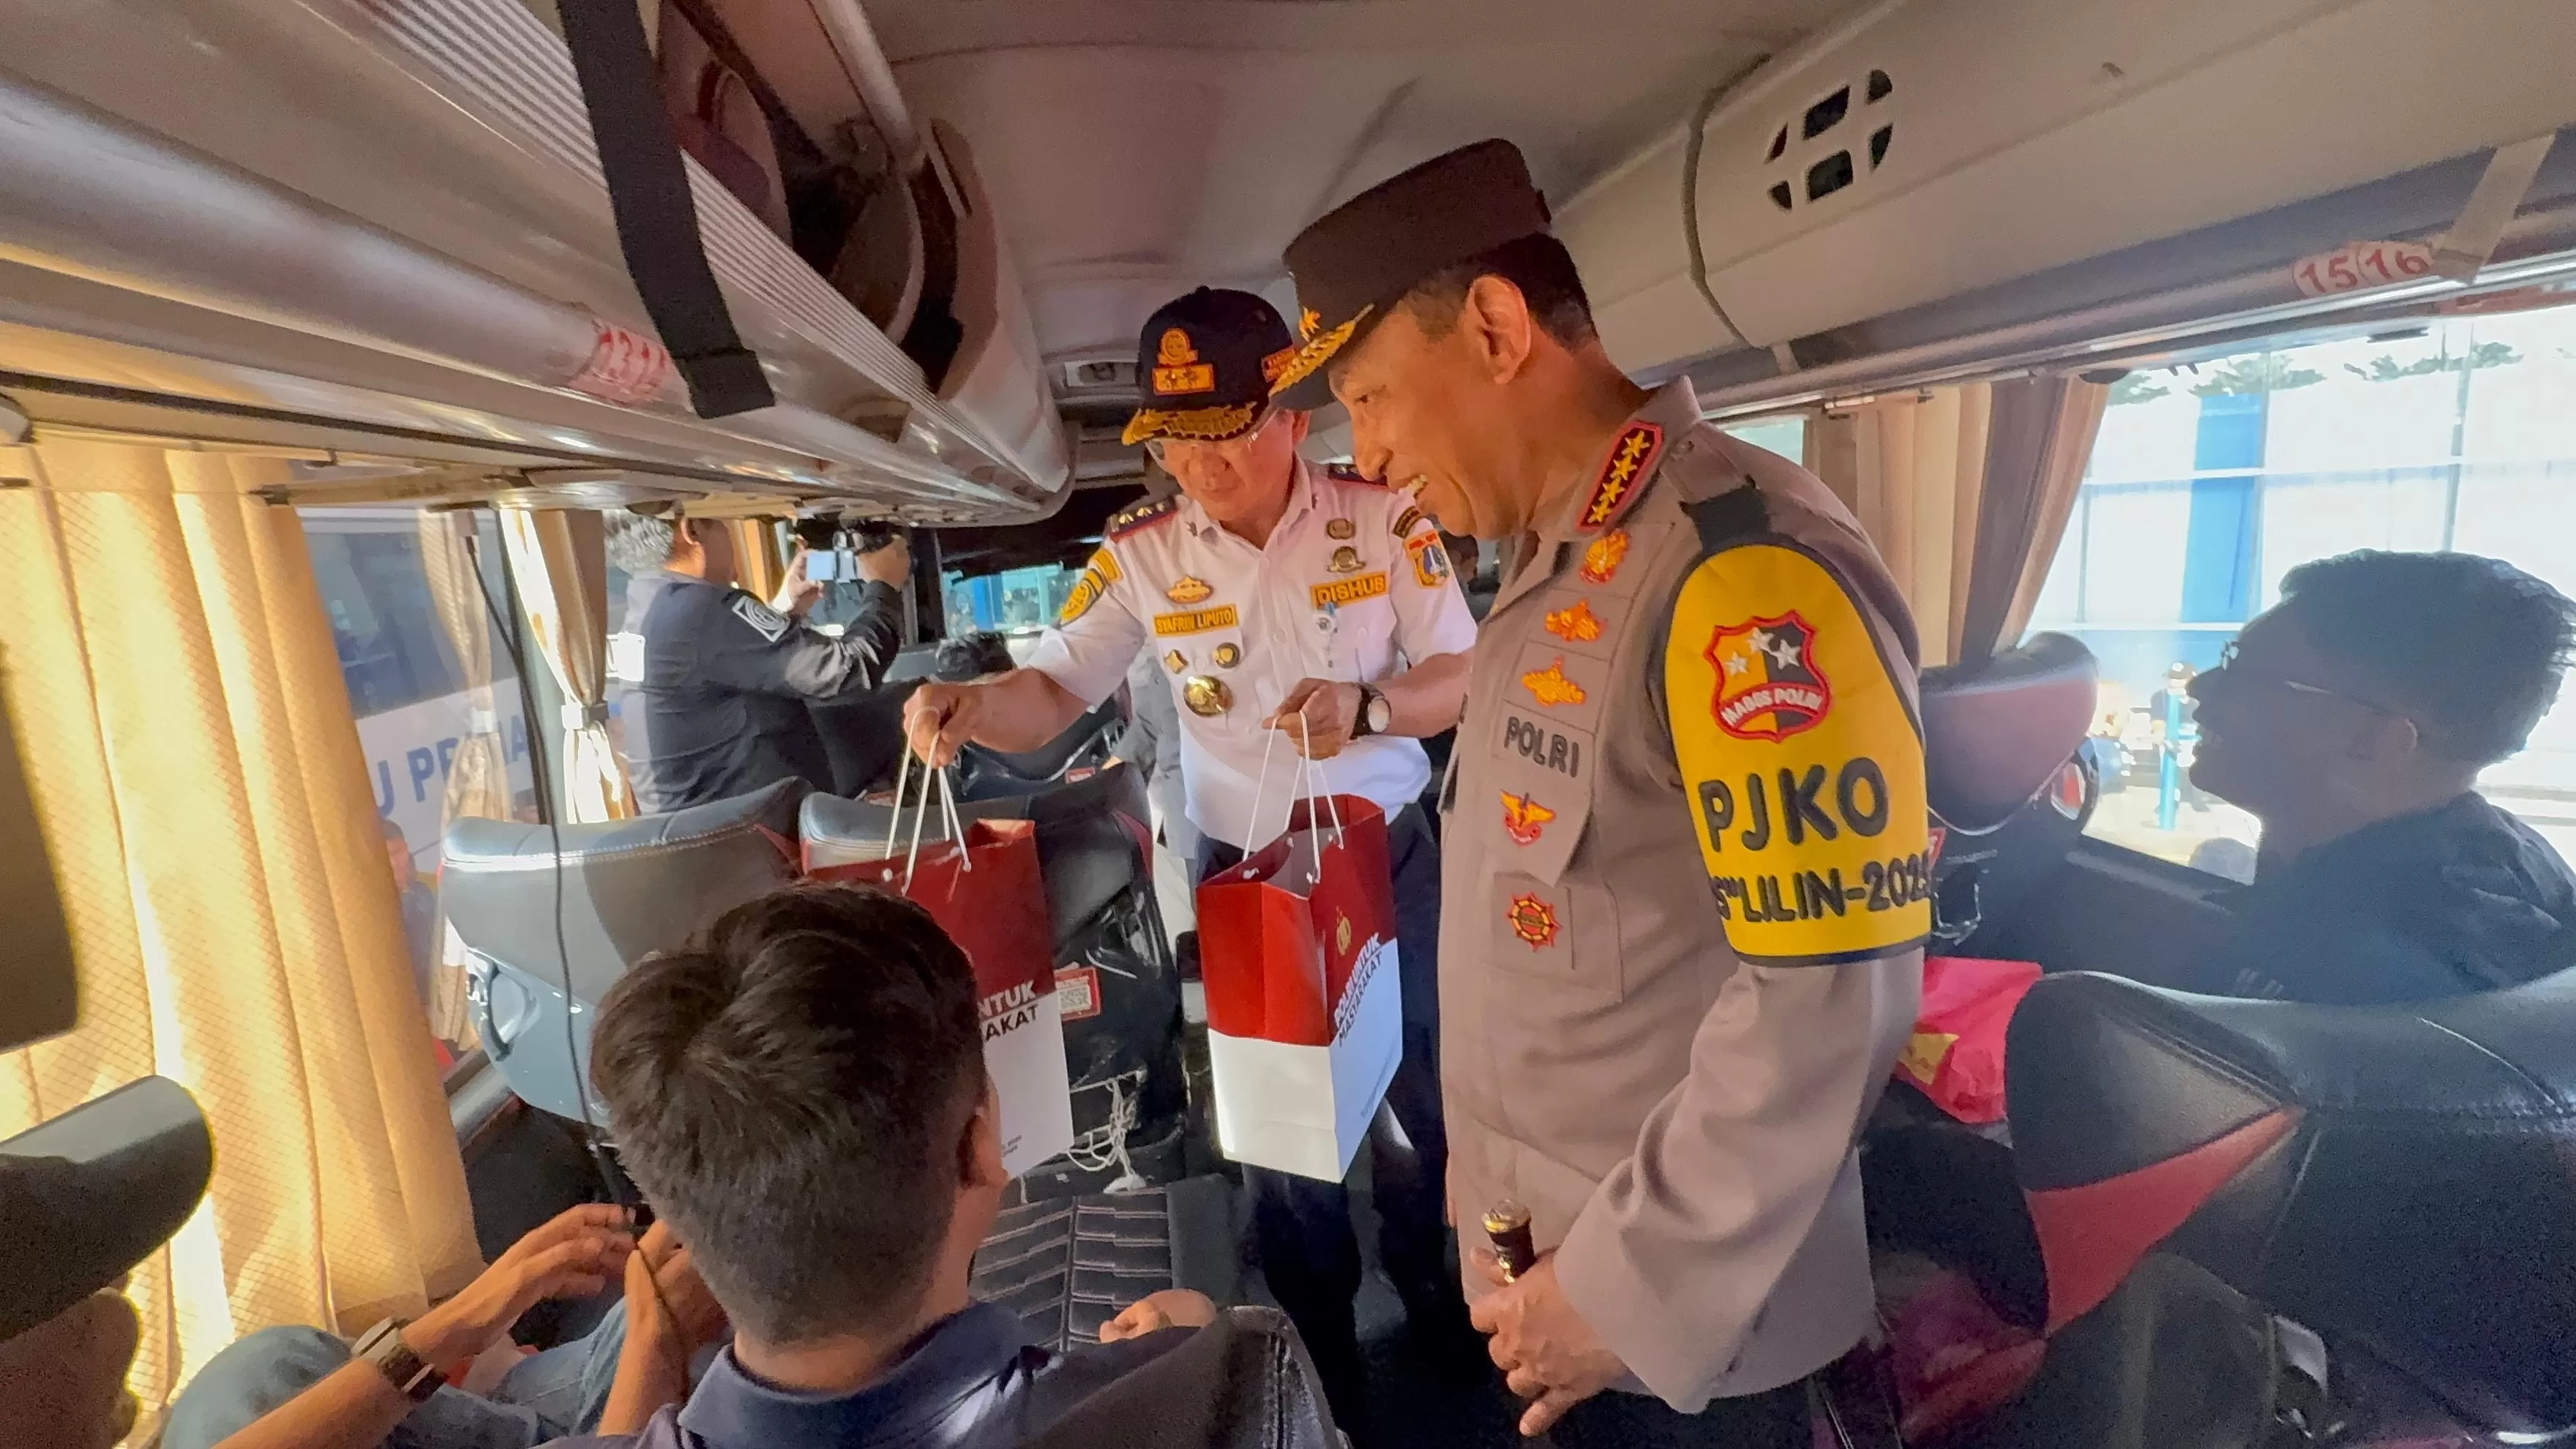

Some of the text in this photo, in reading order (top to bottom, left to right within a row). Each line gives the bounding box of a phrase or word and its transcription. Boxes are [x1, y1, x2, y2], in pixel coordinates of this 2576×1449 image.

[2299, 247, 2430, 293] 15 16
[1317, 575, 1385, 605] DISHUB
[1197, 608, 1233, 629] LIPUTO
[1503, 715, 1580, 779] POLRI
[1697, 756, 1890, 854] PJKO
[976, 979, 1037, 1017] NTUK
[1338, 950, 1382, 1048] MASYARAKAT
[984, 1003, 1038, 1041] AKAT
